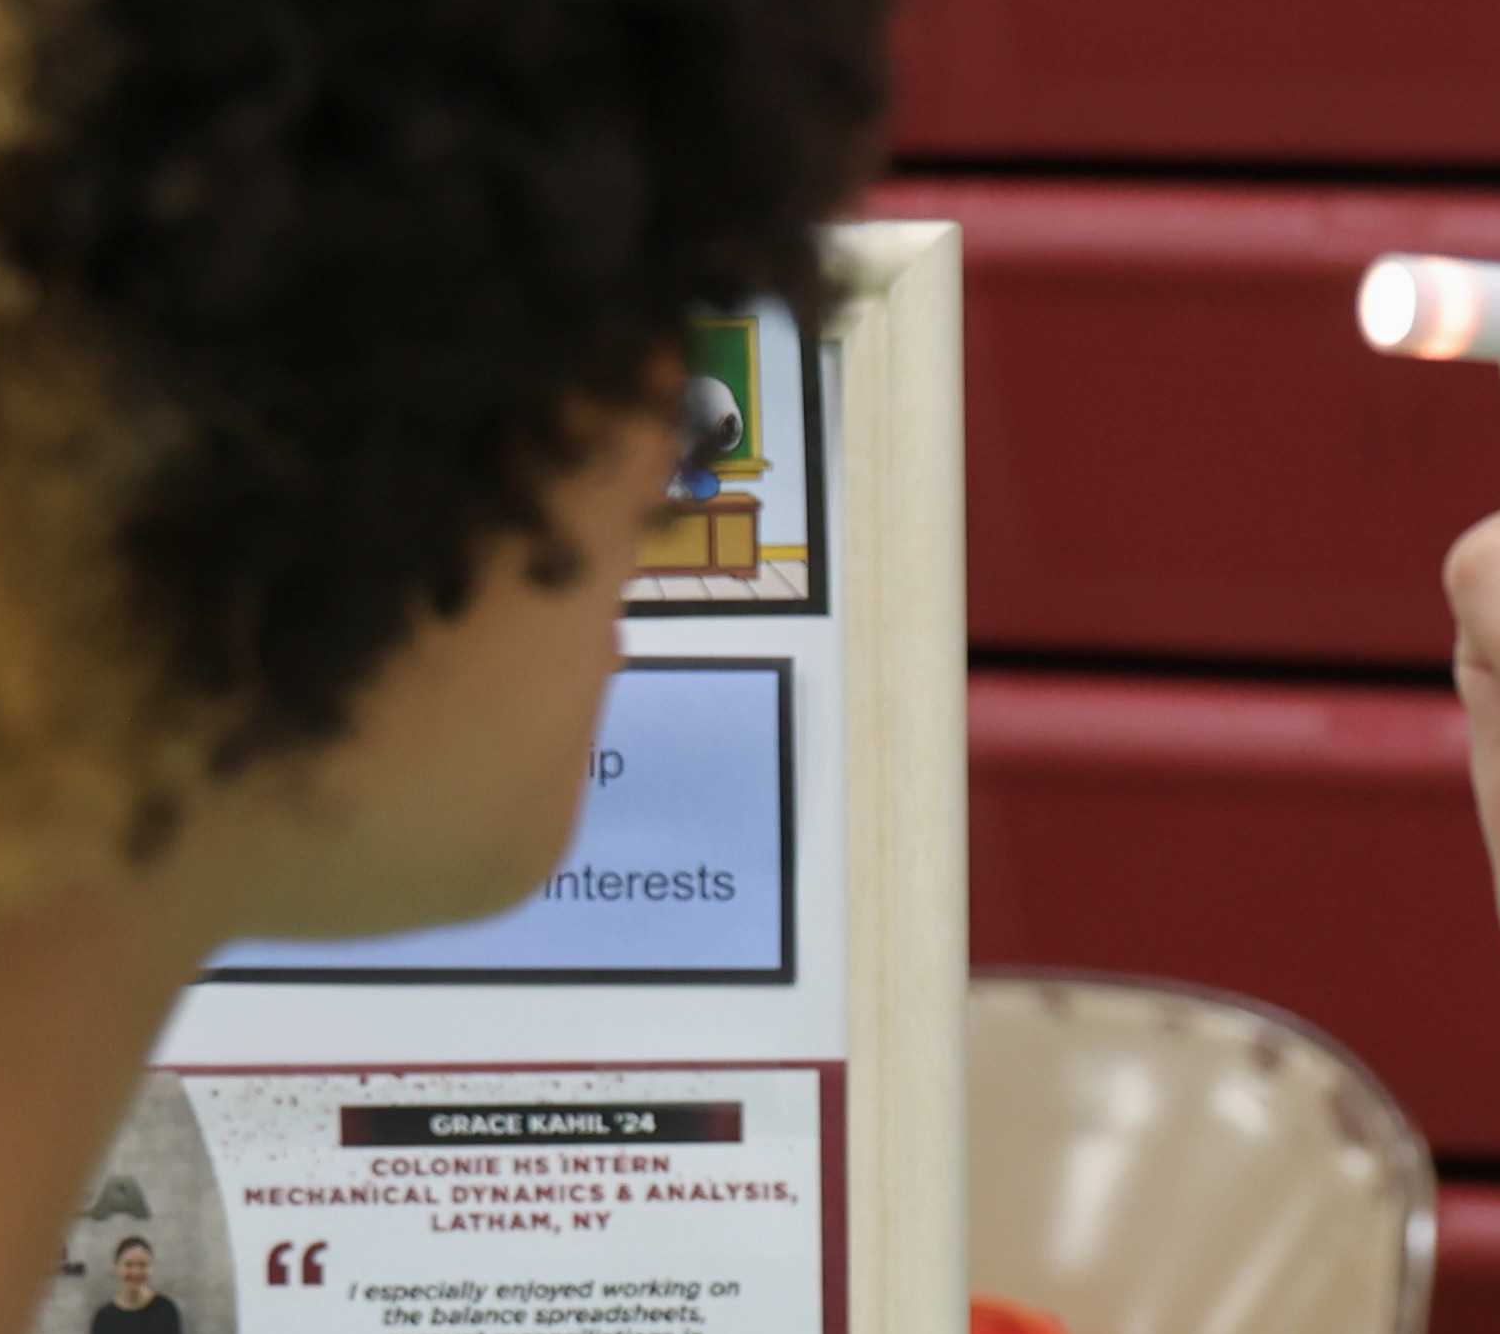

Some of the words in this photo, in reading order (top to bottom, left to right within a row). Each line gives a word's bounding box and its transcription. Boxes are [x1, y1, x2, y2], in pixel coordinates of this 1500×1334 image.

[429, 1112, 522, 1136] GRACE
[528, 1112, 610, 1135] KAHIL
[371, 1157, 501, 1177] COLONIE
[514, 1156, 549, 1175] HS
[562, 1154, 670, 1174] INTERN
[244, 1185, 440, 1206] MECHANICAL
[451, 1183, 604, 1205] DYNAMICS
[616, 1183, 632, 1203] &
[646, 1181, 799, 1204] ANALYSIS,
[431, 1212, 561, 1235] LATHAM,
[572, 1211, 611, 1231] NY
[364, 1280, 488, 1303] especially
[496, 1280, 595, 1302] enjoyed
[603, 1279, 702, 1301] working
[708, 1281, 740, 1298] on
[383, 1307, 422, 1325] the
[430, 1307, 527, 1325] balance
